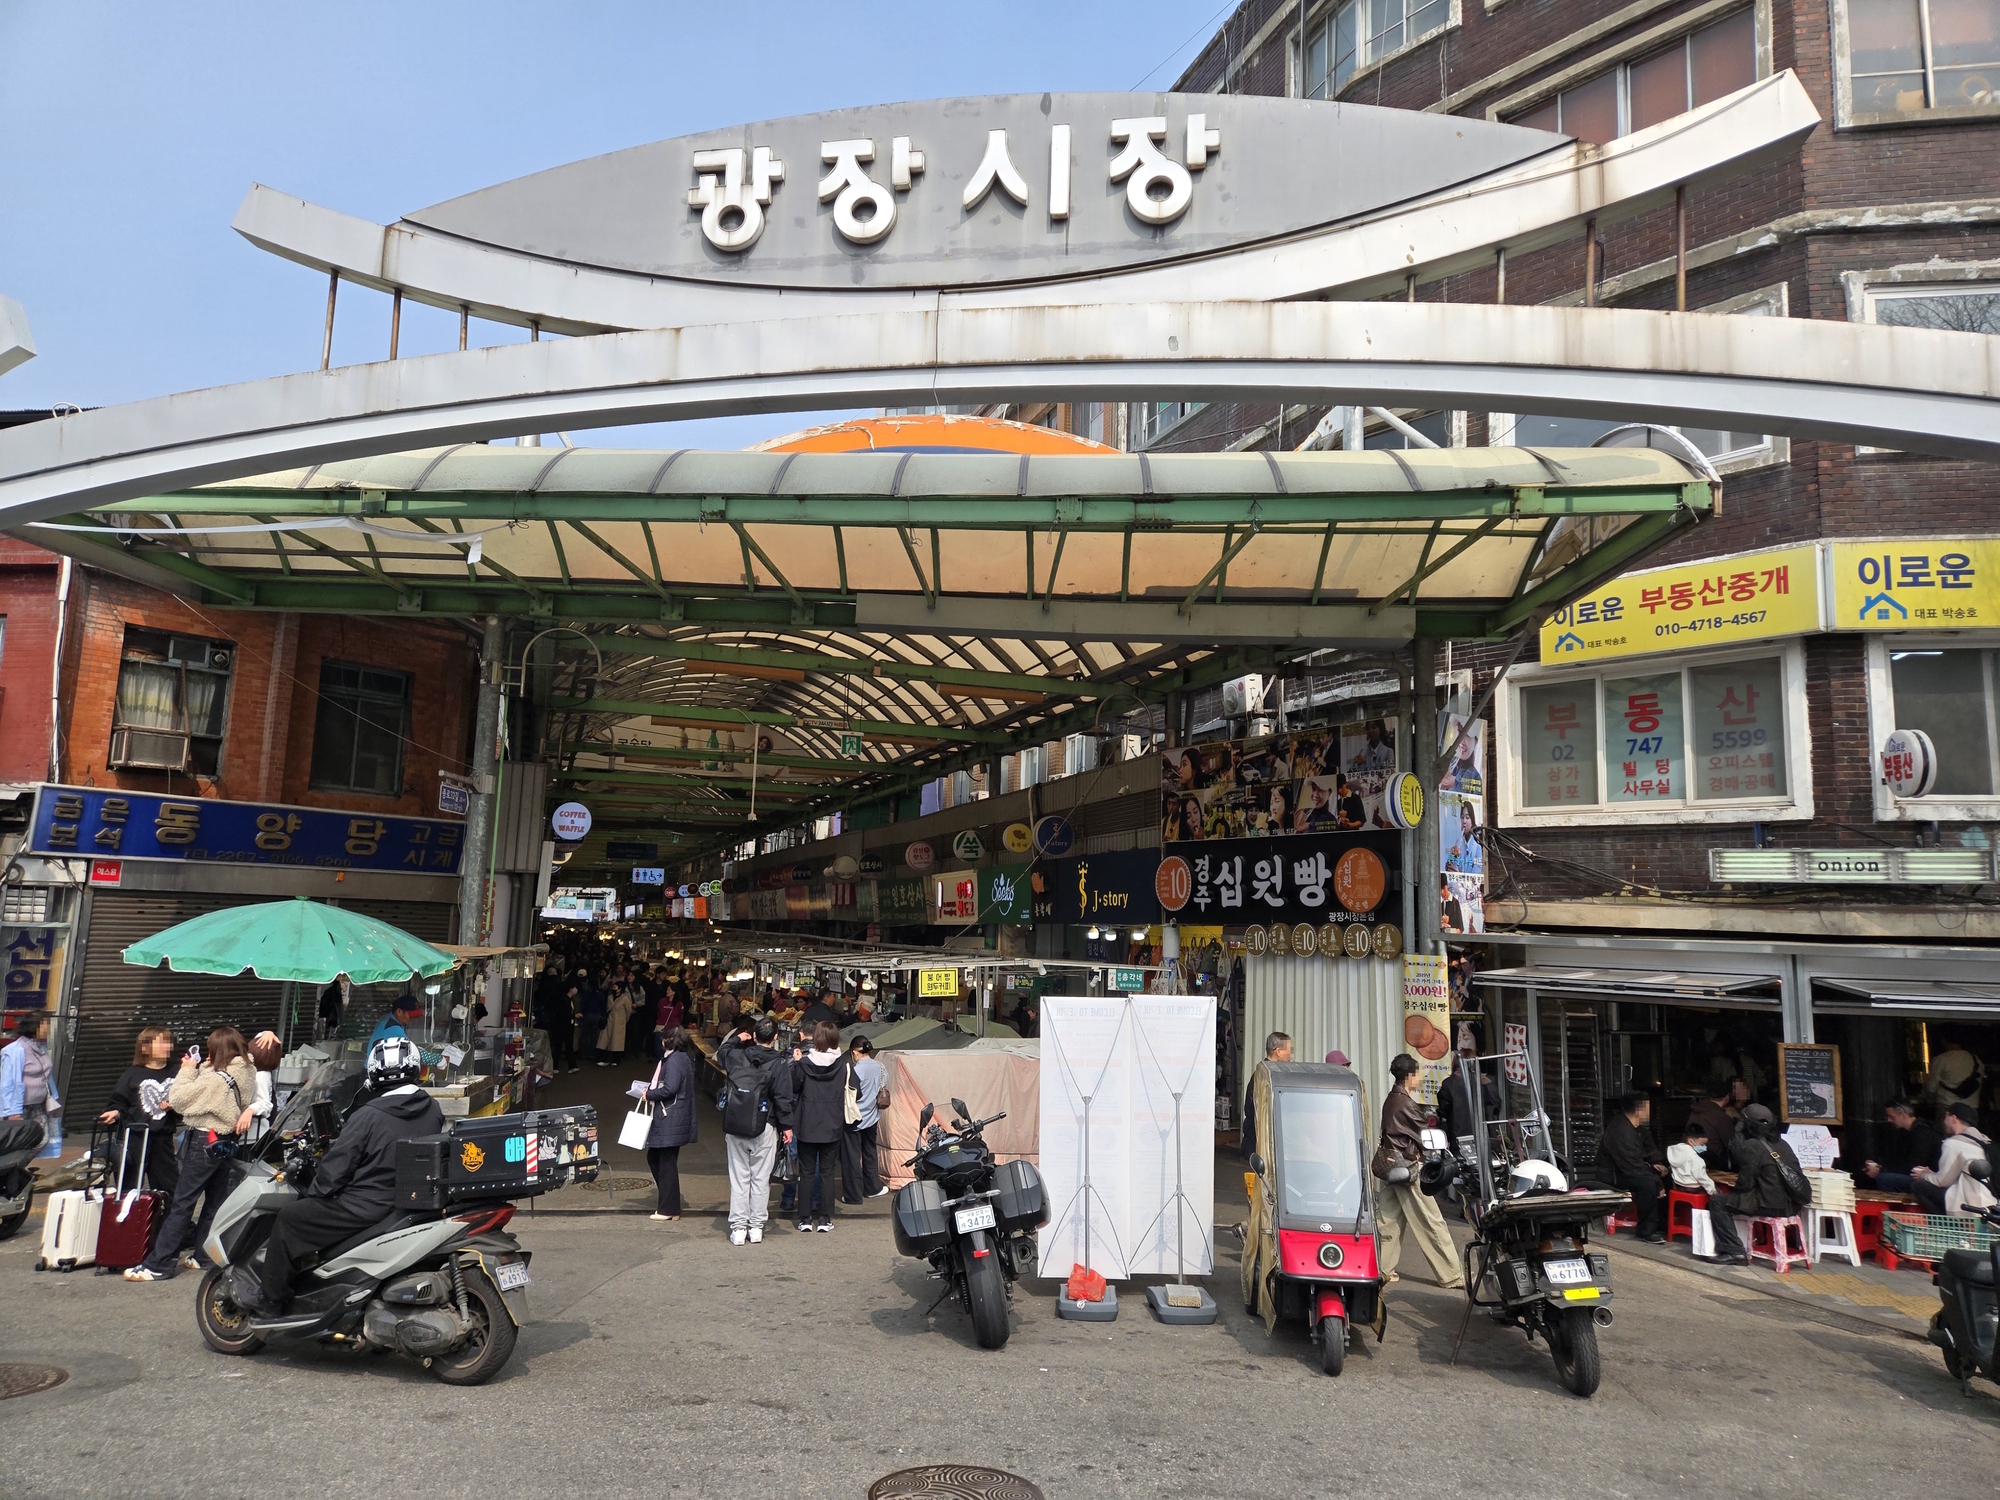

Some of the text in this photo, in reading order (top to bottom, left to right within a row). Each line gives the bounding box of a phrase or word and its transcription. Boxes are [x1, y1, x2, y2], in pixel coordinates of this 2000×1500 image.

[688, 113, 1221, 252] 광장시장
[1858, 553, 1975, 591] 이로운
[1554, 565, 1789, 628] 이로운 부동산중개
[1655, 609, 1767, 637] 010-4718-4567
[1914, 607, 1978, 619] 대표 박송호
[1587, 636, 1628, 649] 대표 박송호
[1551, 728, 1767, 761] 02 747 5599
[1548, 765, 1580, 781] 상가
[1708, 751, 1774, 771] 오피스텔
[1884, 751, 1913, 783] 부동산
[1410, 784, 1422, 817] 10
[1548, 784, 1580, 801] 점포
[1622, 778, 1671, 796] 사무실
[54, 793, 130, 823] 금은
[559, 810, 587, 819] COFFEE
[47, 823, 124, 850] 보석
[154, 801, 388, 856] 동양당
[408, 825, 459, 846] 고급
[558, 824, 585, 833] WAFFLE
[402, 850, 452, 869] 시계
[1818, 857, 1880, 873] onion
[1170, 866, 1187, 899] 10
[1193, 854, 1213, 913] 경주
[1213, 852, 1332, 908] 십원빵
[891, 882, 924, 908] 일호상사
[1254, 930, 1265, 951] 10
[1302, 930, 1315, 951] 10
[1355, 930, 1368, 952] 10
[1121, 972, 1143, 982] 총각네
[1404, 1001, 1448, 1013] 경주십원빵
[967, 1214, 993, 1228] 3472
[508, 1271, 528, 1286] 4910
[1559, 1268, 1587, 1280] 6778
